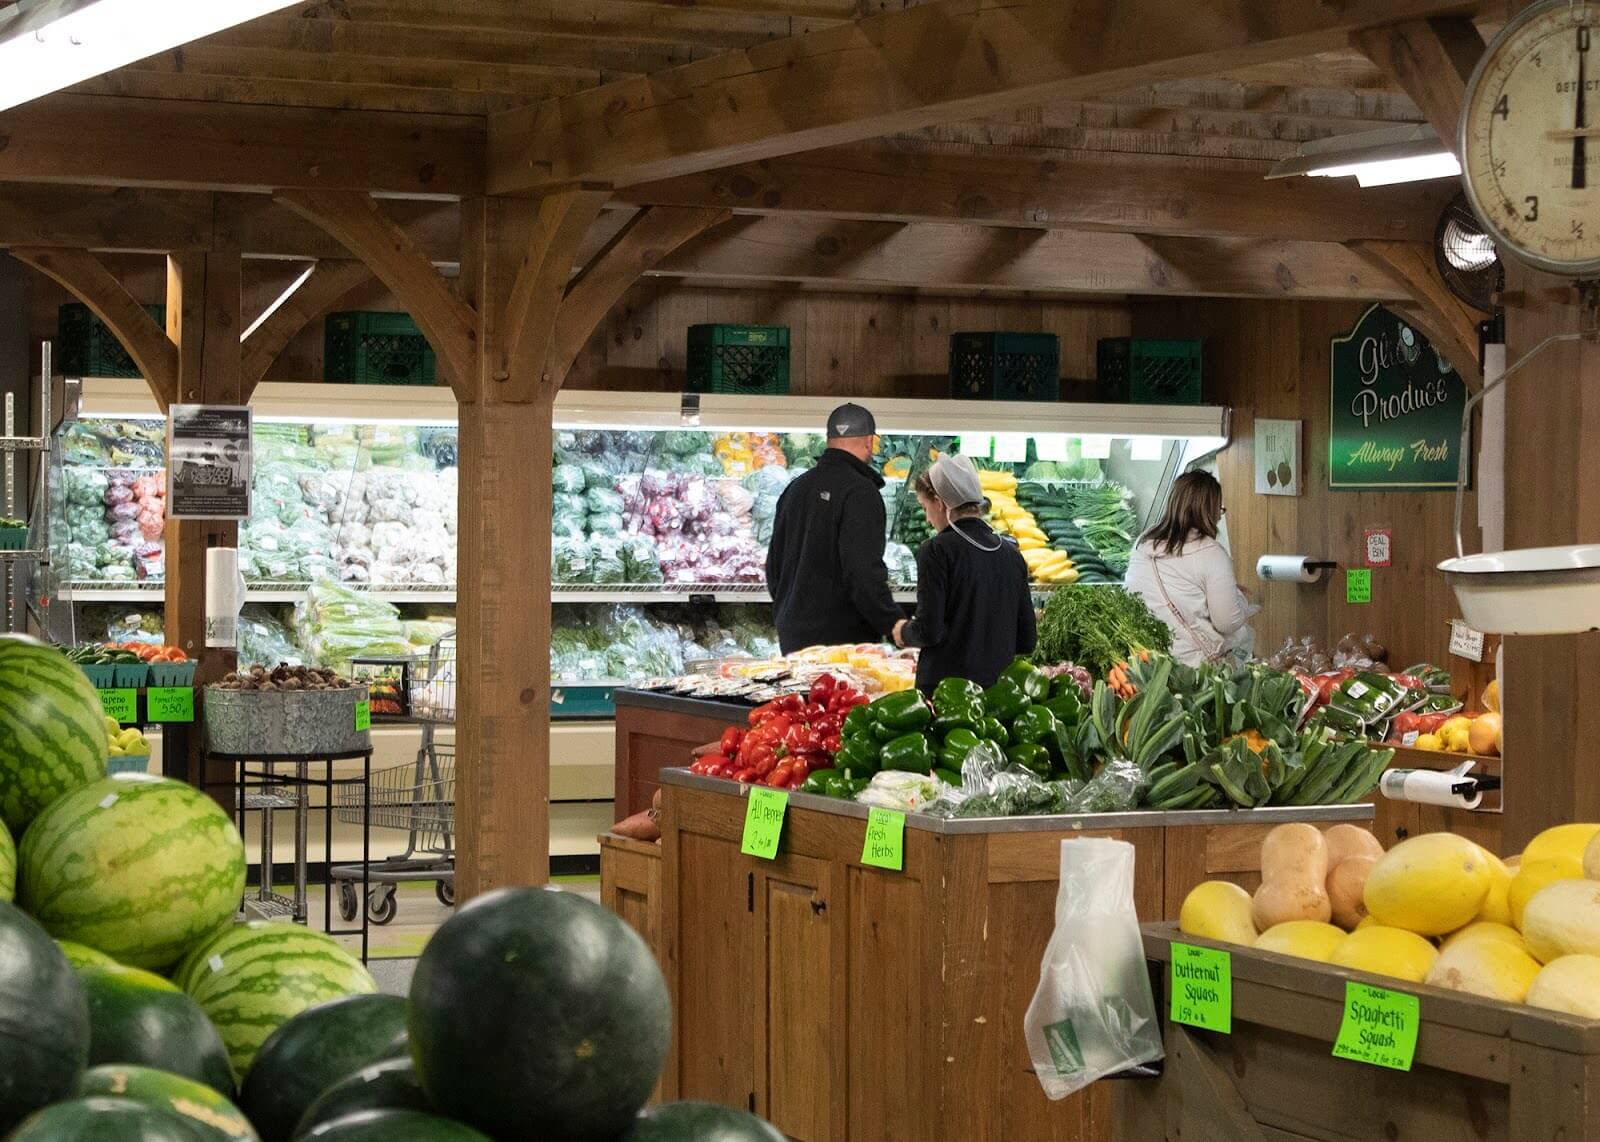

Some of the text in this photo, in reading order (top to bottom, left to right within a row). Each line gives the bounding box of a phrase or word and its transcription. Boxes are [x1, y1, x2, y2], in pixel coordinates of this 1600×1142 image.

[1576, 26, 1590, 51] 0
[1493, 94, 1509, 120] 4
[1524, 195, 1539, 222] 3
[1351, 378, 1448, 427] Produce
[1409, 439, 1448, 462] Fresh
[1372, 547, 1385, 557] BIN
[751, 799, 762, 820] All
[871, 841, 894, 858] Herbs
[1175, 960, 1220, 983] butternut
[1184, 984, 1219, 1006] Squash
[1350, 1000, 1405, 1032] Spaghetti
[1358, 1028, 1396, 1050] Squash
